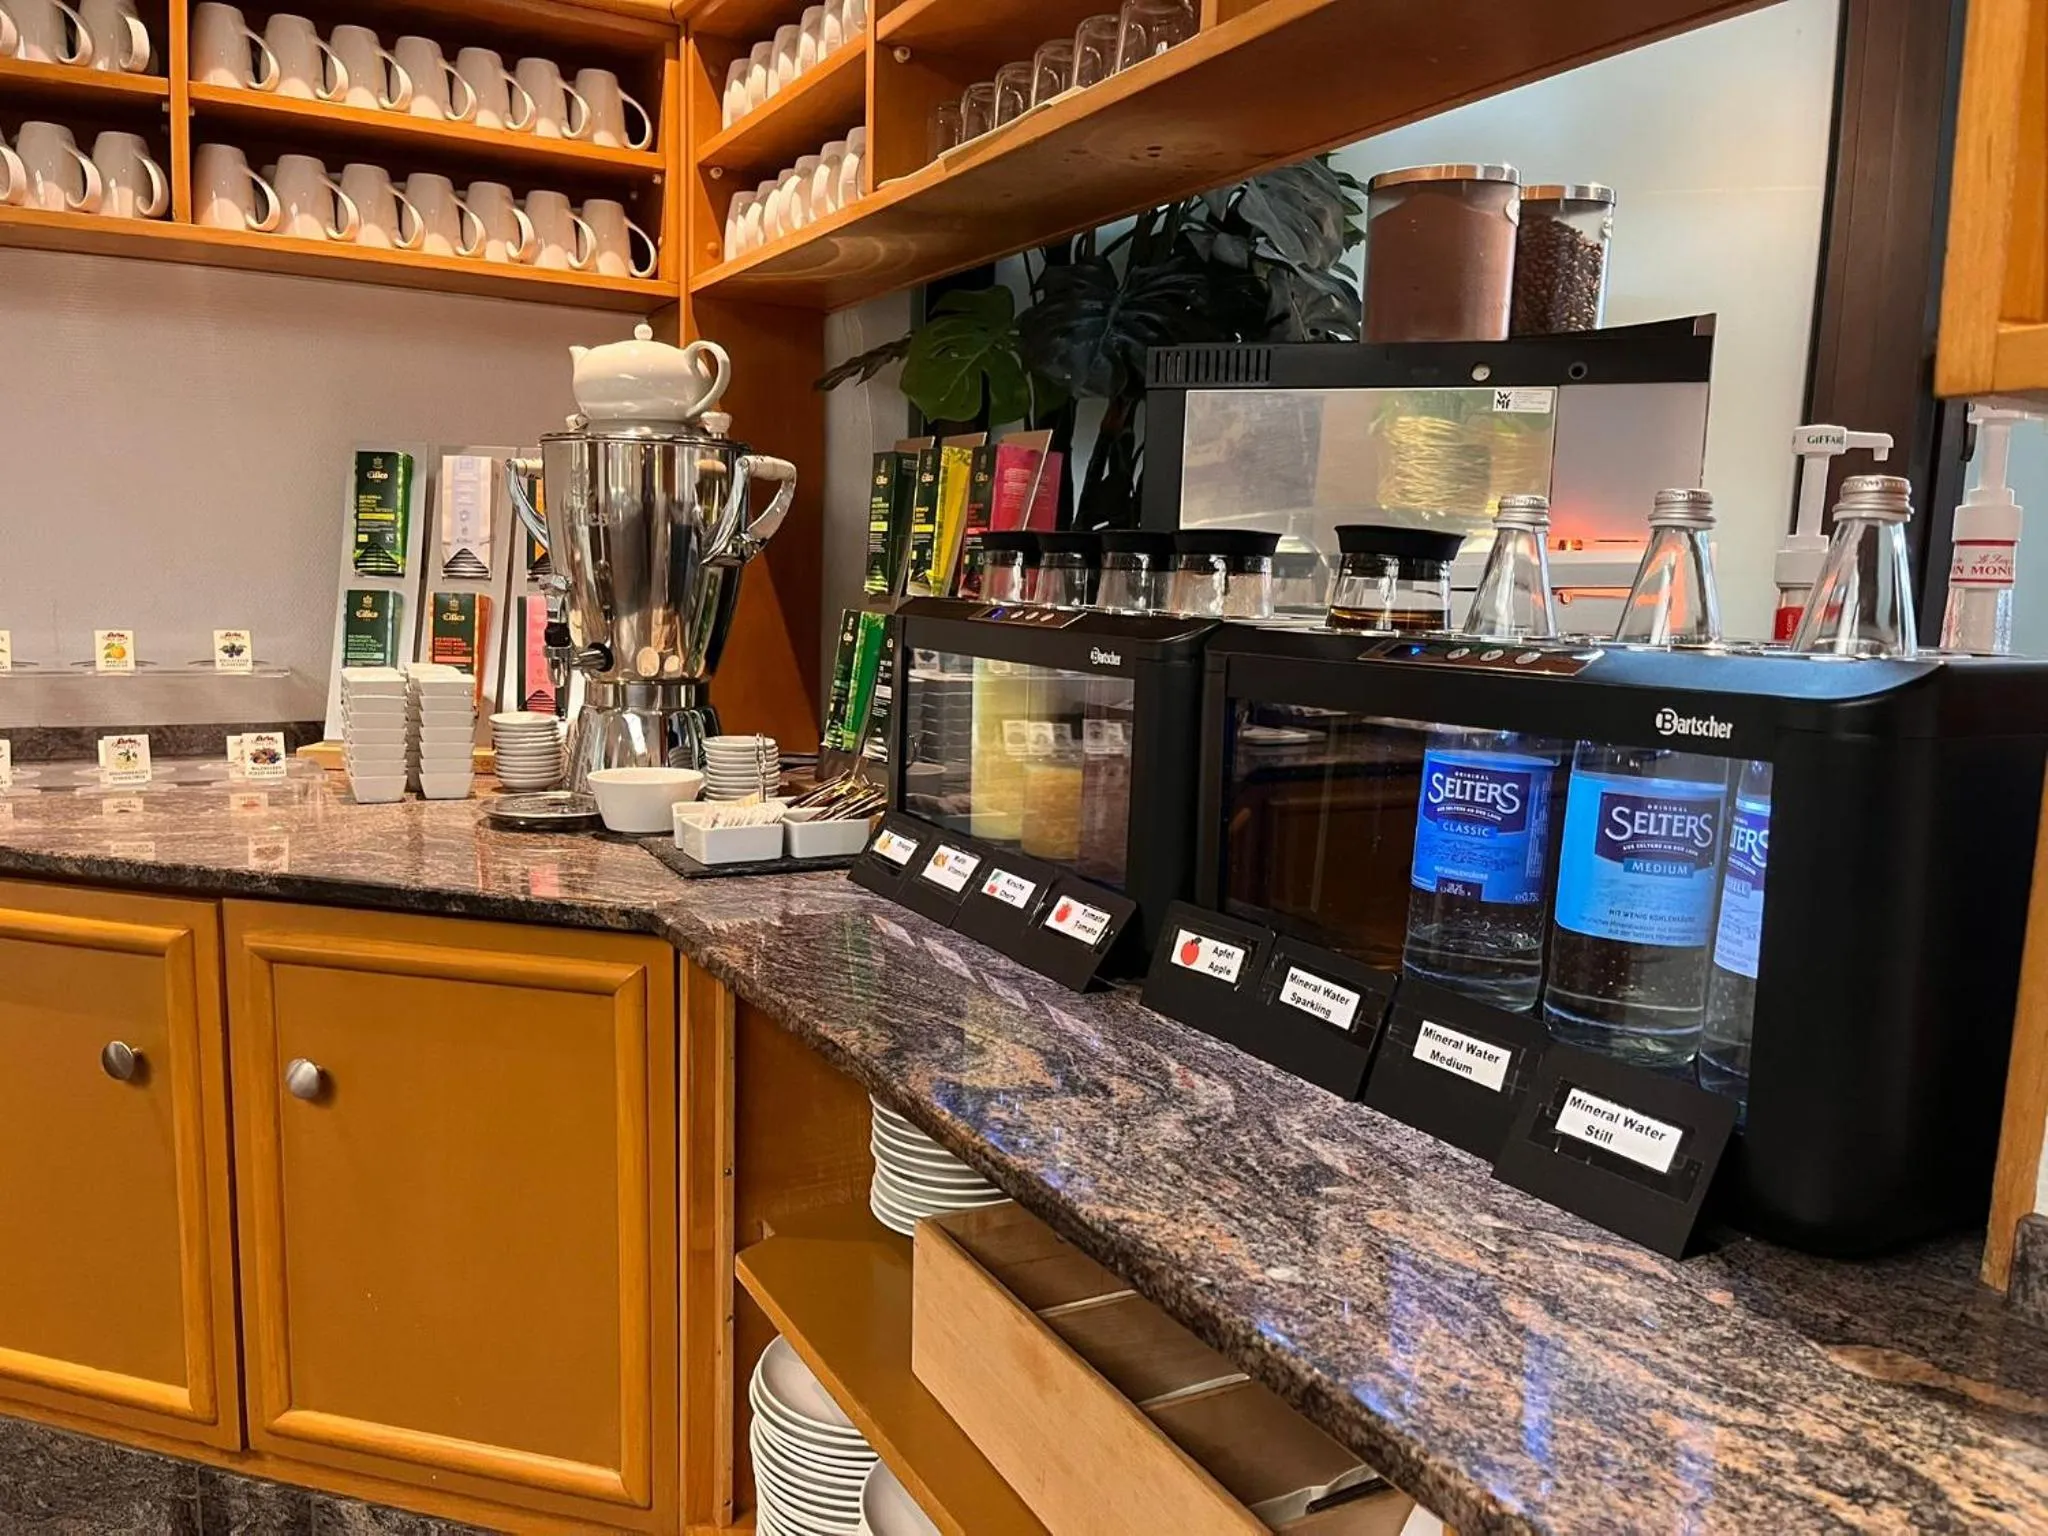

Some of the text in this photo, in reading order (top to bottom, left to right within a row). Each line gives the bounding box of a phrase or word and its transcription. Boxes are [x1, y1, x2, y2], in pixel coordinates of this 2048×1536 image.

[1655, 707, 1734, 740] Bartscher
[1427, 771, 1521, 815] SELTERS
[1647, 804, 1688, 813] ORIGINAL
[1442, 822, 1490, 837] CLASSIC
[1604, 805, 1713, 848] SELTERS
[1631, 861, 1688, 875] MEDIUM
[1212, 945, 1236, 961] Apfel
[1208, 961, 1232, 977] Apple
[1288, 972, 1350, 1006] Mineral Water
[1290, 992, 1332, 1020] Sparkling
[1423, 1026, 1501, 1065] Mineral Water
[1429, 1049, 1474, 1076] Medium
[1568, 1095, 1667, 1142] Mineral Water
[1584, 1124, 1614, 1145] Still
